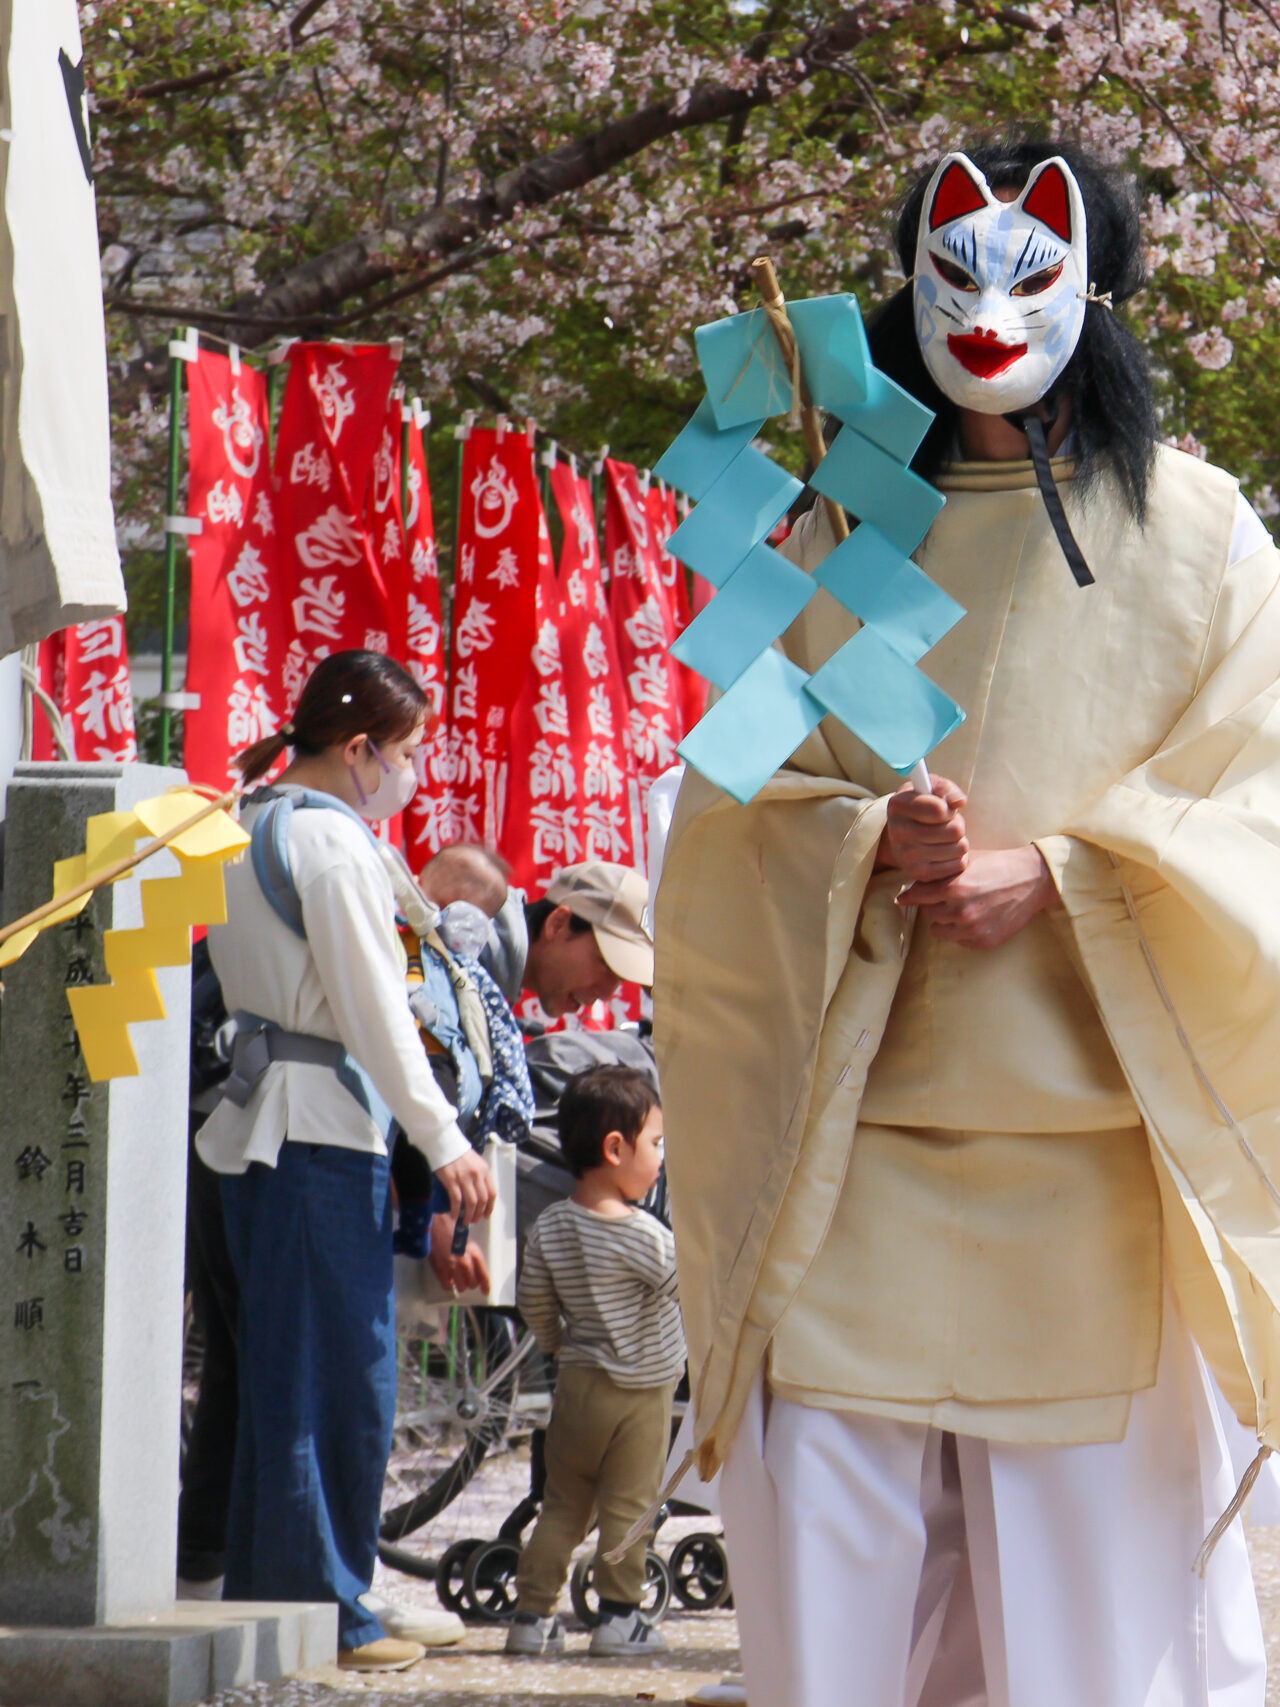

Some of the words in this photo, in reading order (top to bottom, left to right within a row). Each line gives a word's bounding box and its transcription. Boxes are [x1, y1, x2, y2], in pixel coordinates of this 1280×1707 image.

[61, 910, 95, 1273] 平成十年三月吉日
[12, 1144, 52, 1388] 鈴木順一
